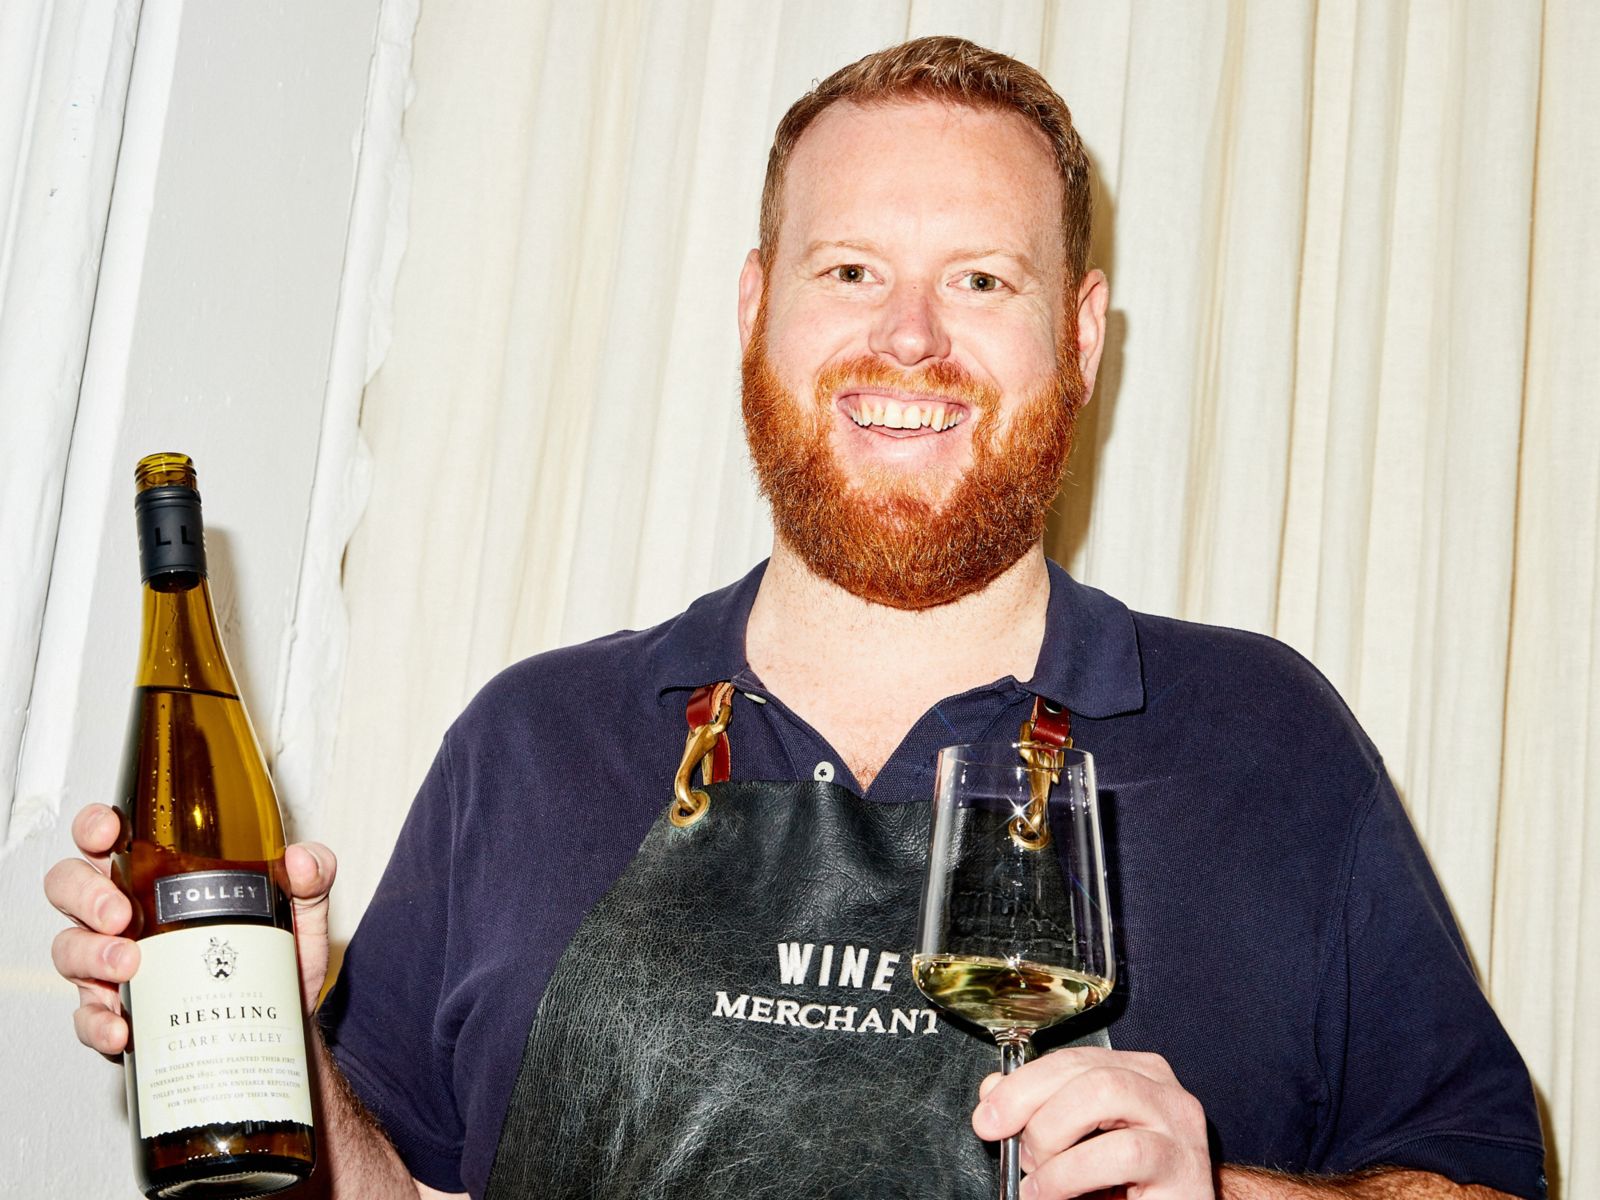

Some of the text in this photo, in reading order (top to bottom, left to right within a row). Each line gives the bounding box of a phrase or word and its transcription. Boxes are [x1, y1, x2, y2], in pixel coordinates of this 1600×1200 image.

[169, 886, 258, 904] TOLLEY
[777, 941, 900, 992] WINE
[170, 1006, 277, 1027] RIESLING
[712, 991, 939, 1034] MERCHANT
[168, 1033, 282, 1051] CLARE VALLEY
[226, 1055, 259, 1063] PLANTED
[260, 1055, 281, 1063] THEIR
